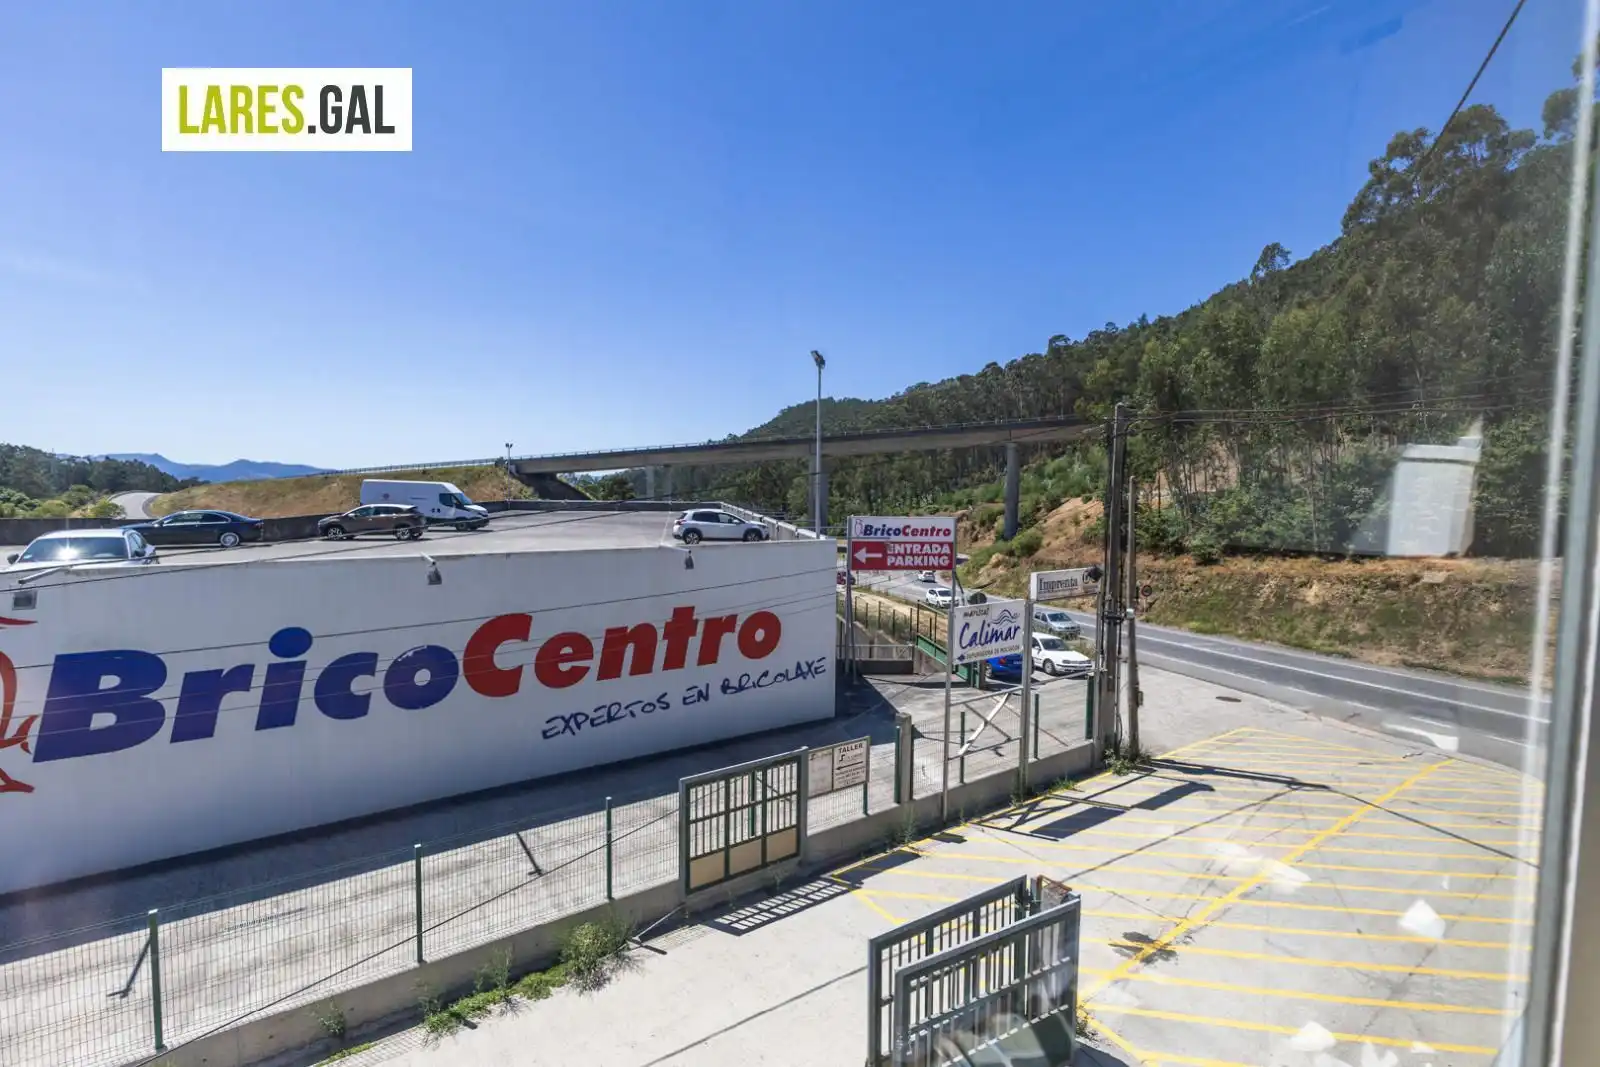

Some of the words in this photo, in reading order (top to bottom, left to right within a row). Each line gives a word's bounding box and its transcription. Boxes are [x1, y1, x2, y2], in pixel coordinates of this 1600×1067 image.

[863, 523, 952, 537] BricoCentro
[886, 543, 951, 555] ENTRADA
[886, 554, 950, 567] PARKING
[959, 619, 1021, 650] Calimar
[32, 605, 782, 763] BricoCentro
[542, 692, 671, 740] EXPERTOS
[682, 683, 709, 705] EN
[720, 656, 828, 696] BRICOLAXE
[838, 743, 863, 753] TALLER
